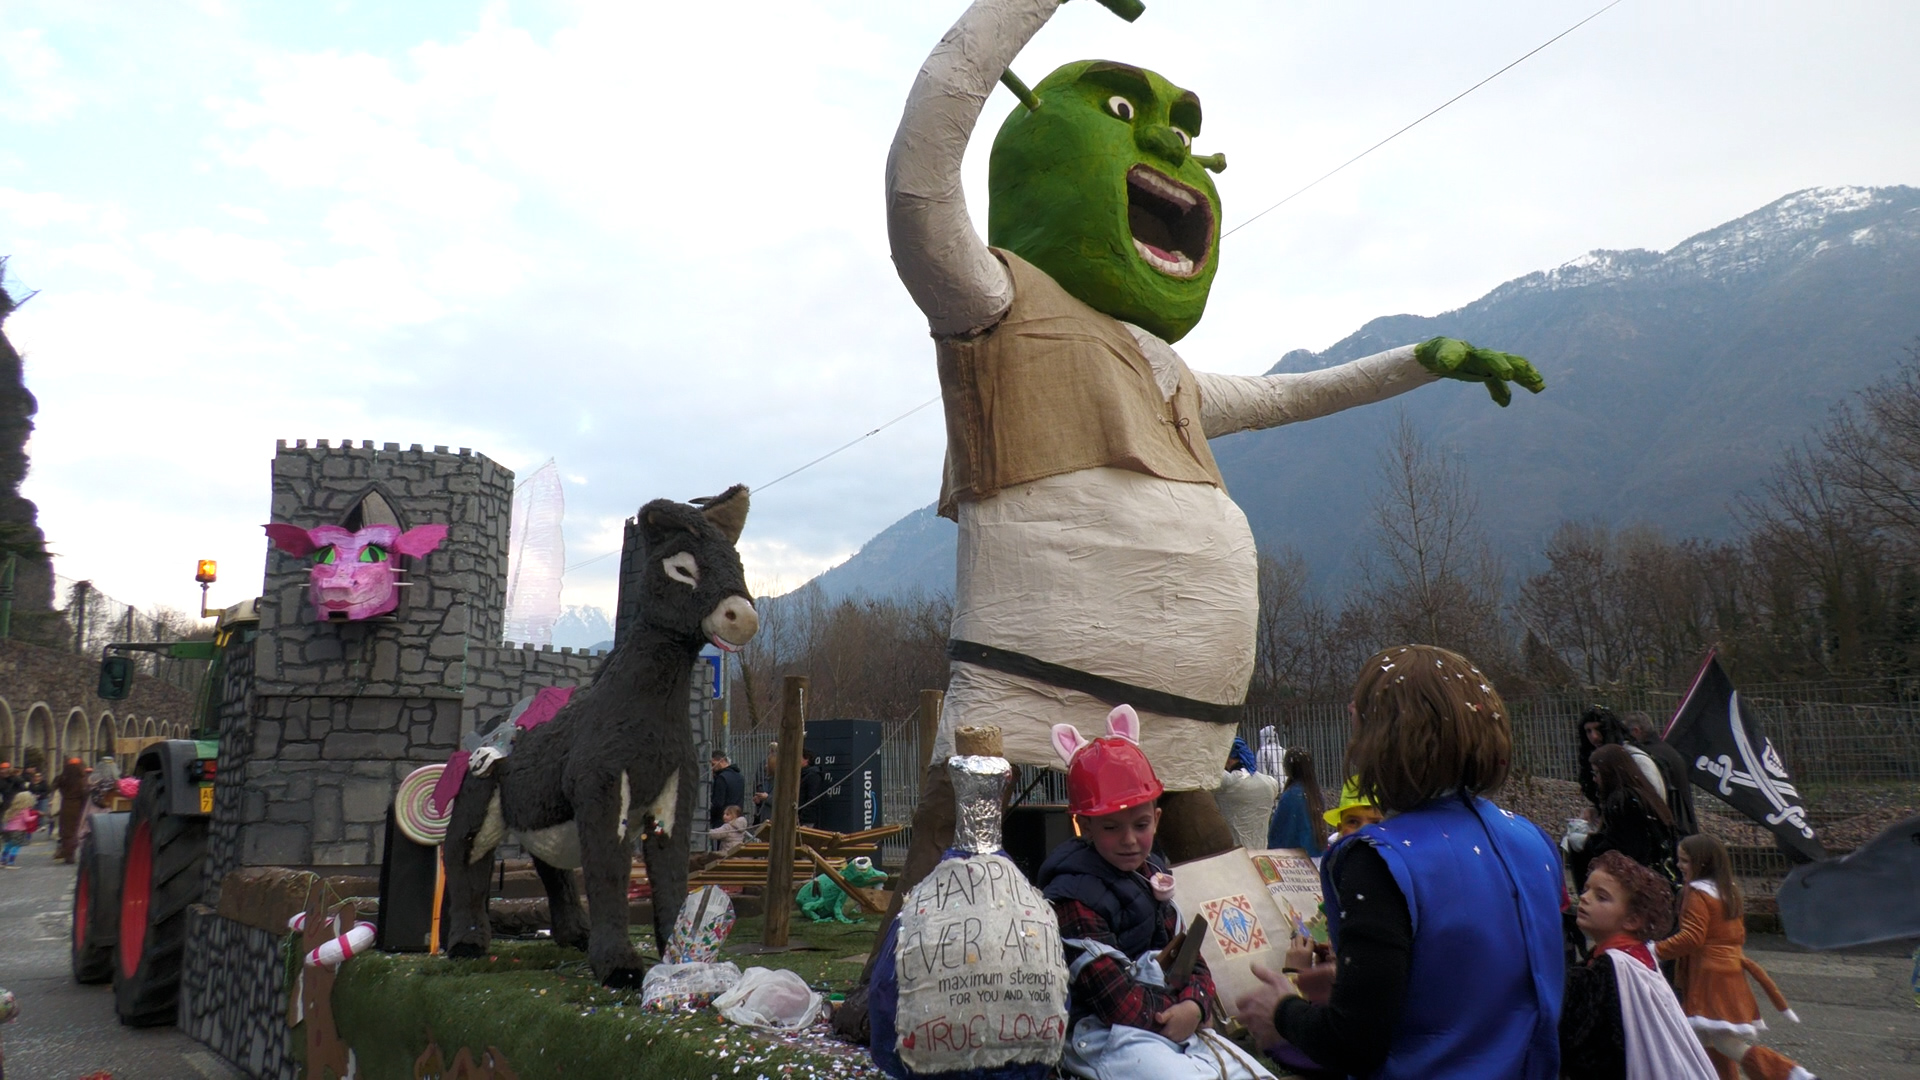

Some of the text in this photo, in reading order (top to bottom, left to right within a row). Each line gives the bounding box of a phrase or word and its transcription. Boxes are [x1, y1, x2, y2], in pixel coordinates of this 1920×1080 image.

[901, 917, 982, 982] EVER
[938, 967, 1056, 993] maximum strength
[950, 989, 1051, 1006] FOR YOU AND YOUR
[916, 1013, 1060, 1051] TRUE LOVE
